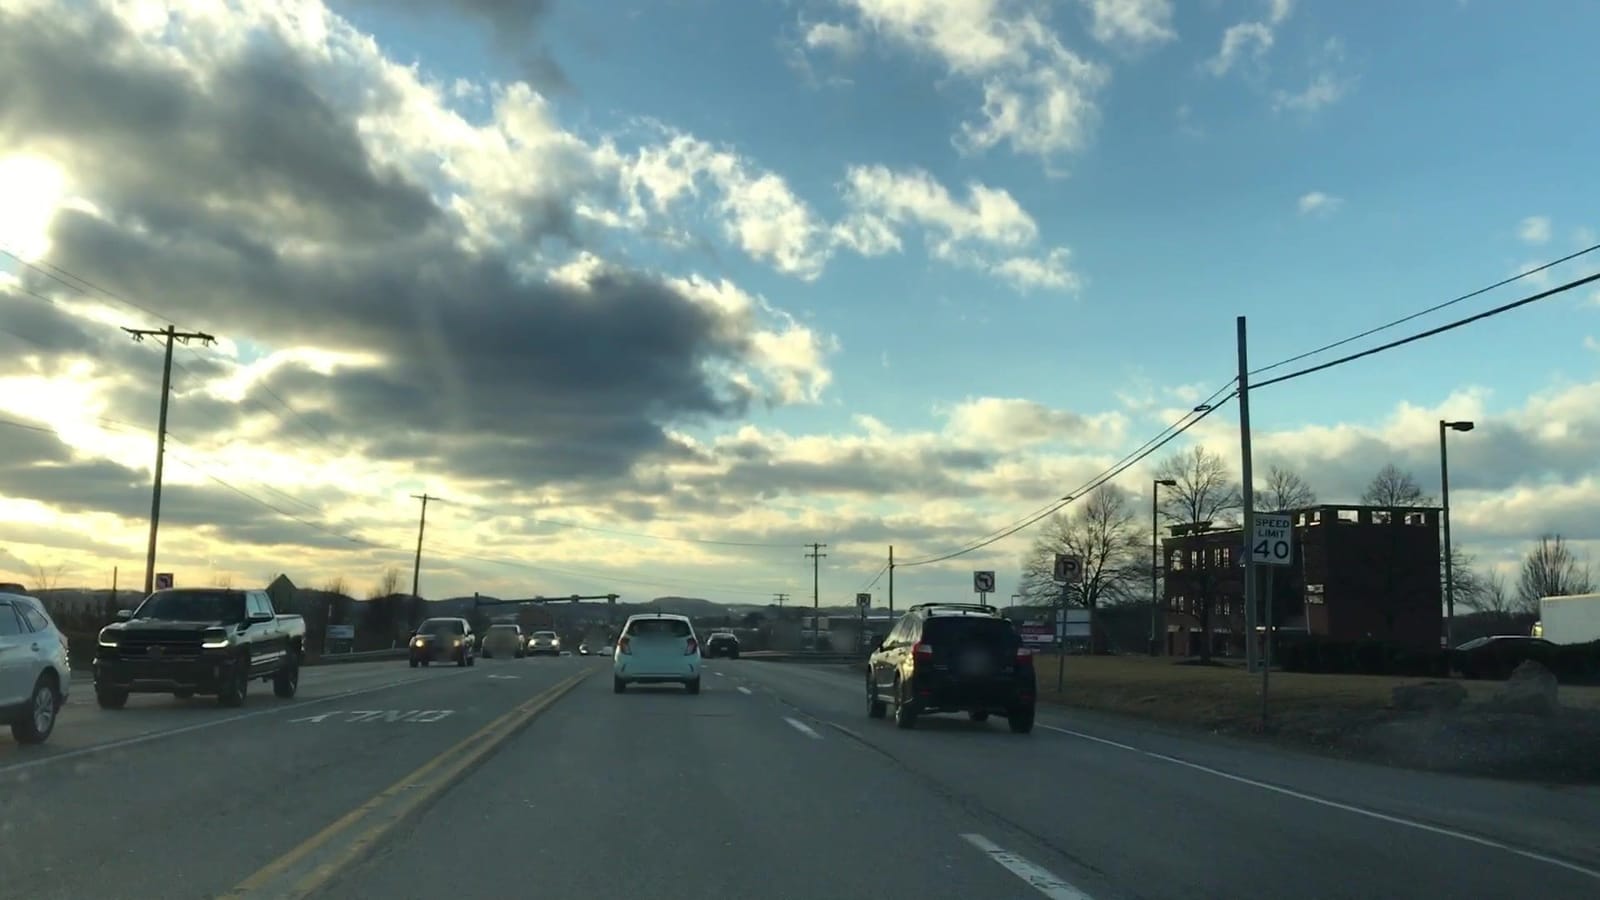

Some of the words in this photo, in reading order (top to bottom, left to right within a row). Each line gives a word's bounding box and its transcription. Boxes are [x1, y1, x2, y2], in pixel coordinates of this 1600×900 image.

[1255, 518, 1290, 528] SPEED
[1258, 529, 1285, 538] LIMIT
[1253, 539, 1289, 559] 40
[288, 710, 455, 723] ONLY
